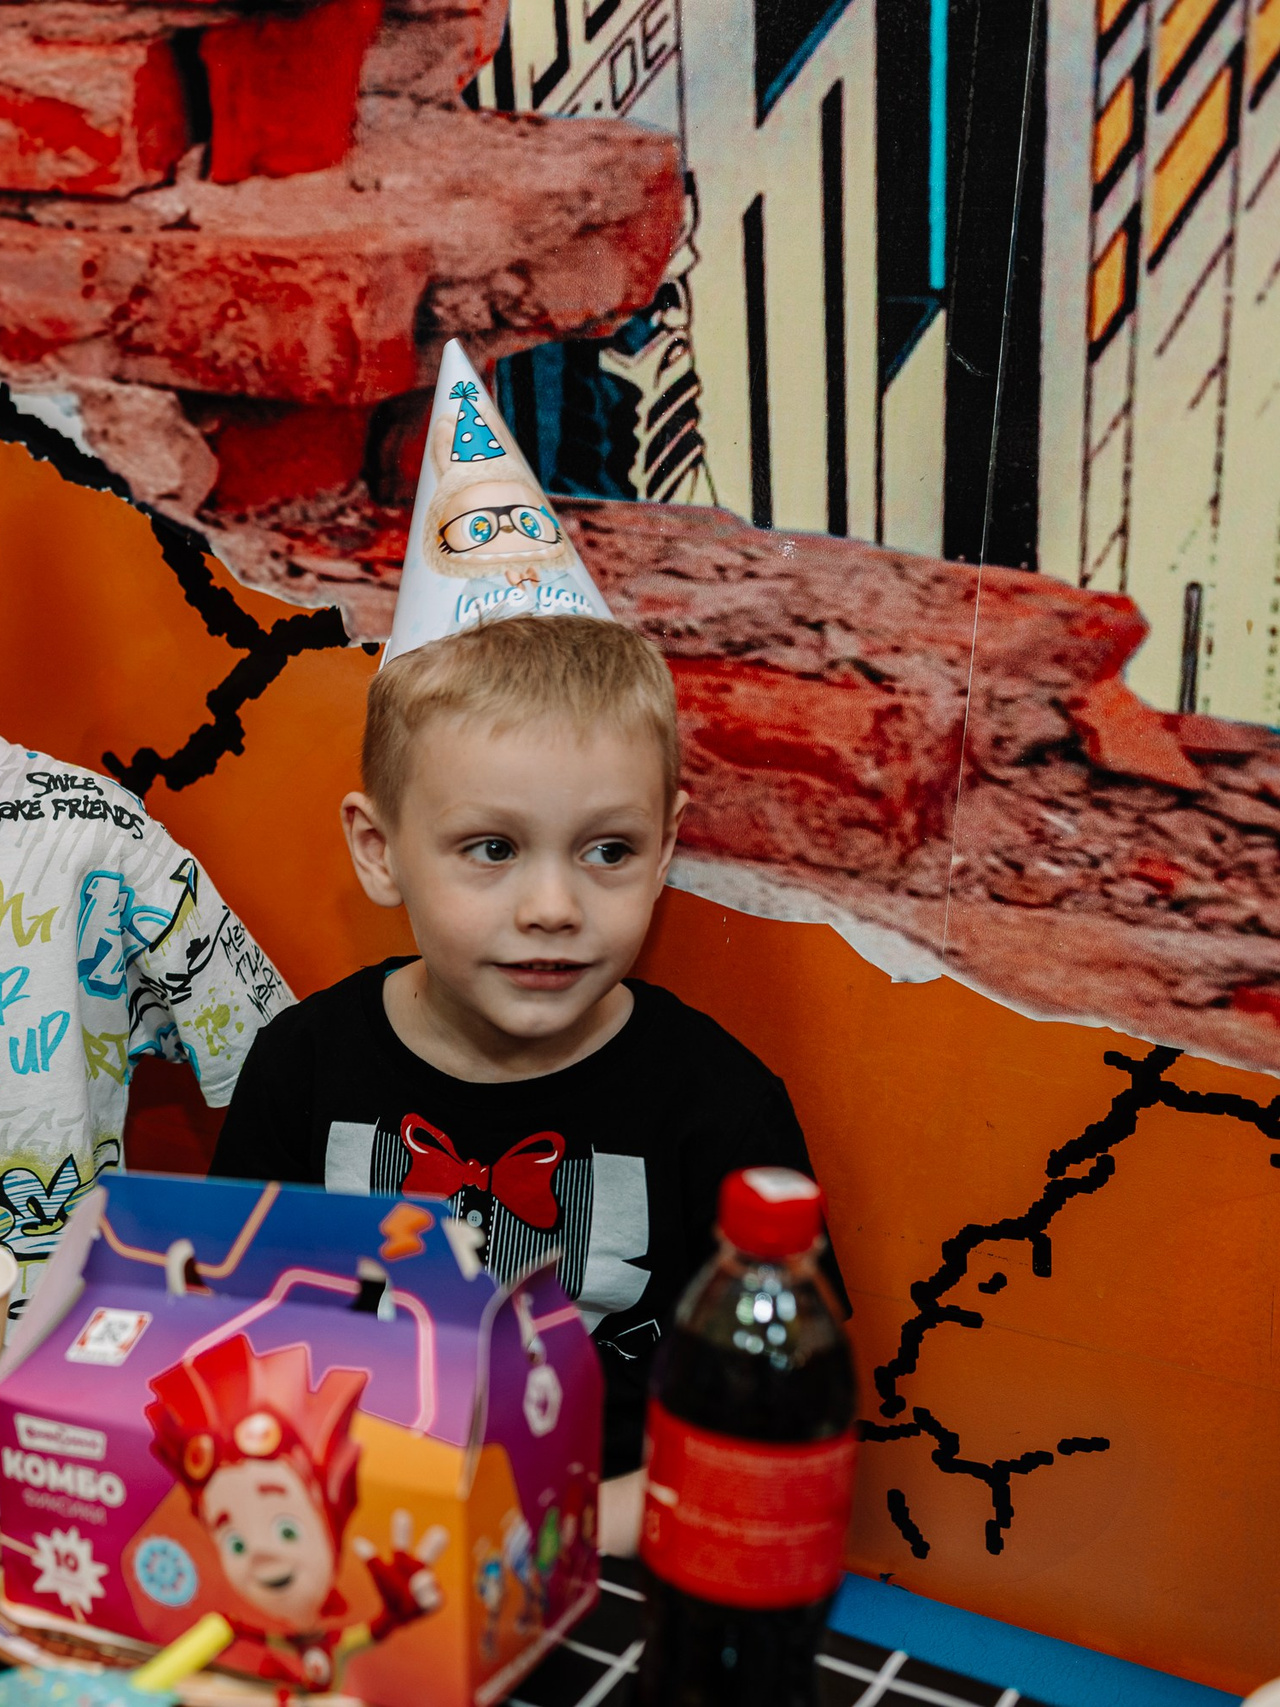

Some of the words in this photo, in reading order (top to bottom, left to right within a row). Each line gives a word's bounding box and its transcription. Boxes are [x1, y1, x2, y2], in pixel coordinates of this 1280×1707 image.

[536, 585, 593, 614] you
[9, 1010, 71, 1075] UP
[53, 1547, 79, 1572] 10
